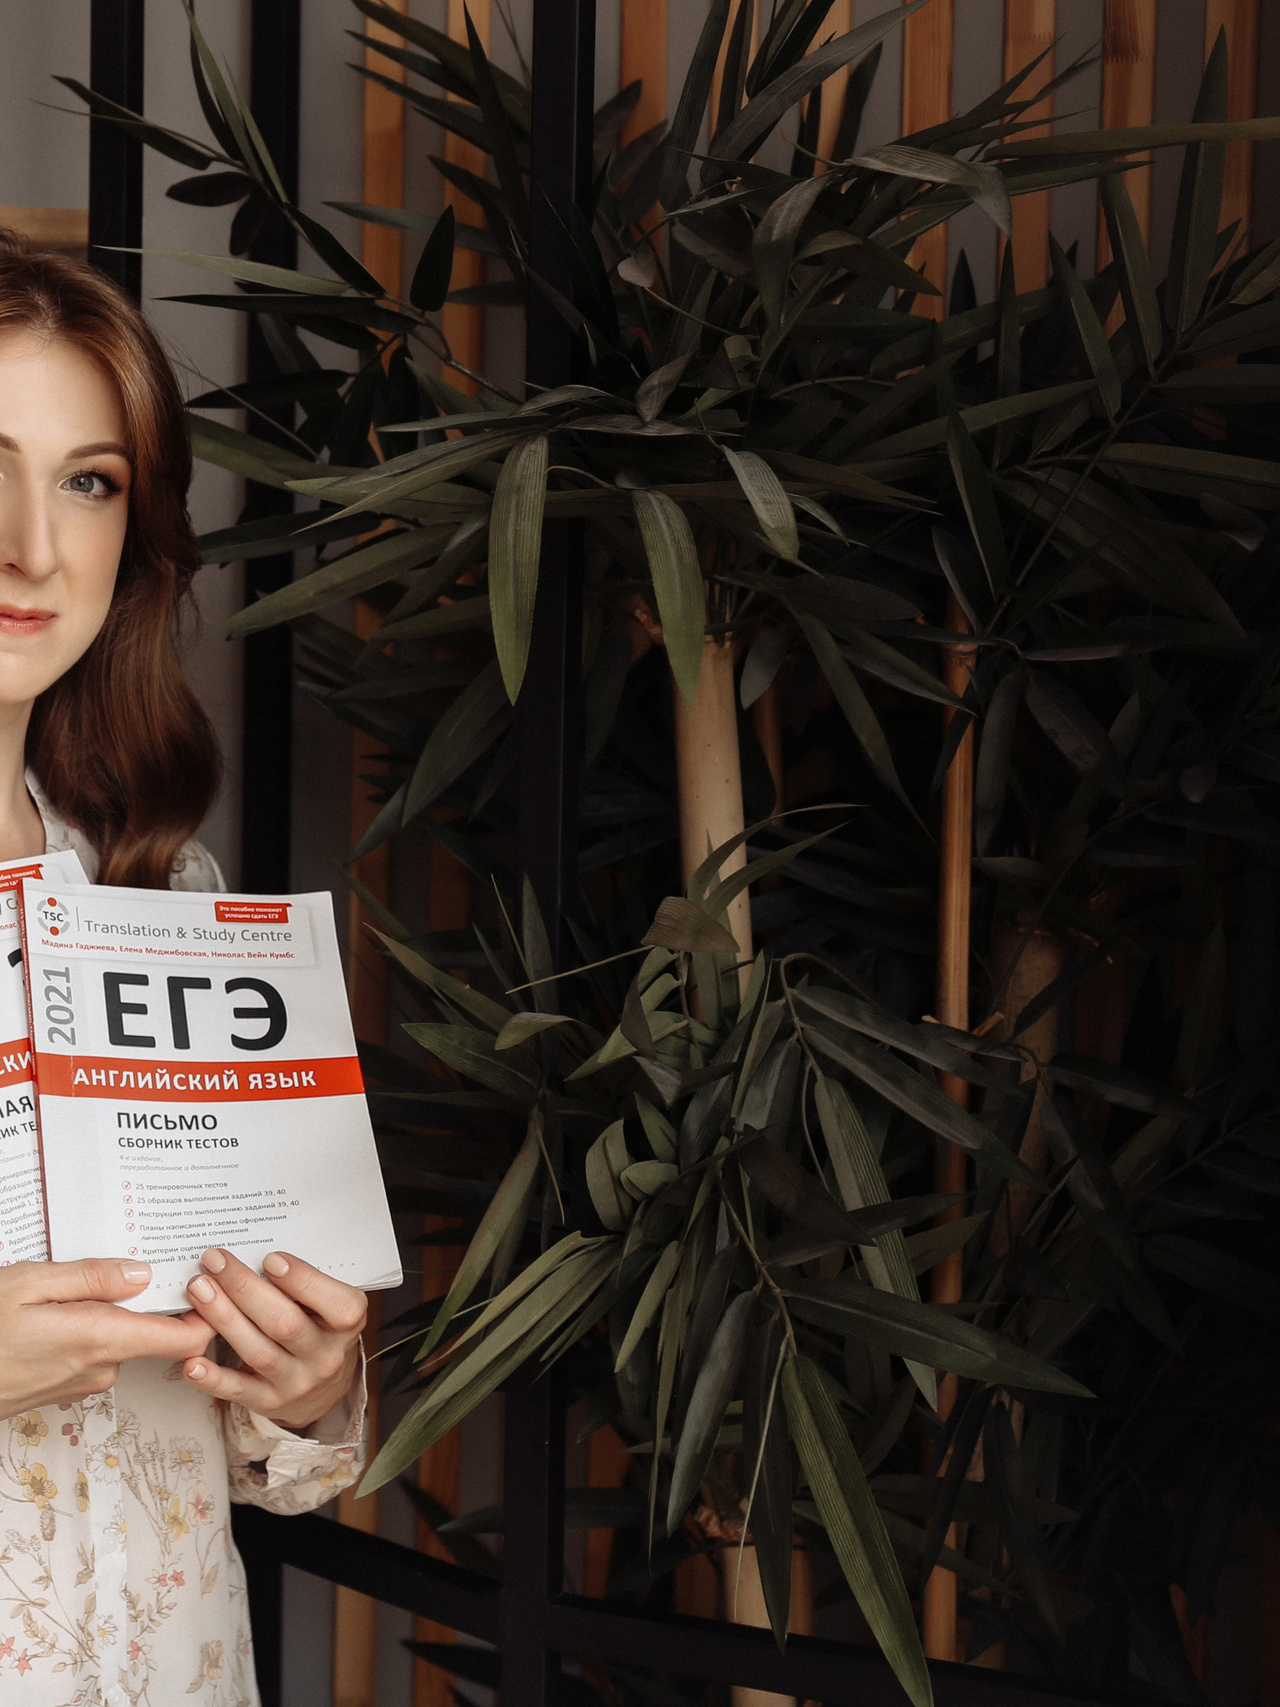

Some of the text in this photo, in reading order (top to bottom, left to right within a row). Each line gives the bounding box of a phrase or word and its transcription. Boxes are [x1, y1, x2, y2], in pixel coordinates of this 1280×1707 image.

[42, 911, 64, 922] TSC
[84, 920, 293, 944] Translation & Study Centre
[41, 939, 73, 949] Мадина
[75, 943, 118, 953] Гаджиева,
[119, 946, 143, 954] Елена
[211, 951, 245, 959] Николас
[247, 951, 268, 959] Вейн
[269, 951, 295, 960] Кумбс
[43, 967, 76, 1046] 2021
[103, 971, 288, 1051] ЕГЭ
[74, 1068, 317, 1091] АНГЛИЙСКИЙ ЯЗЫК
[116, 1112, 219, 1131] ПИСЬМО
[118, 1137, 240, 1150] СБОРНИК ТЕСТОВ
[0, 1179, 32, 1194] образцов
[146, 1183, 203, 1191] тренировочных
[147, 1197, 182, 1205] образцов
[183, 1195, 230, 1203] выполнения
[231, 1192, 262, 1200] заданий
[0, 1209, 42, 1227] Подробные
[138, 1211, 182, 1219] Инструкции
[194, 1207, 243, 1216] выполнению
[244, 1202, 276, 1211] заданий
[4, 1228, 13, 1236] на
[140, 1224, 165, 1232] Планы
[166, 1222, 206, 1231] написания
[213, 1219, 238, 1227] схемы
[239, 1214, 287, 1224] оформления
[208, 1227, 249, 1236] сочинения
[8, 1229, 47, 1247] Аудиозапи
[142, 1237, 274, 1256] Критерии оценивания выполнения
